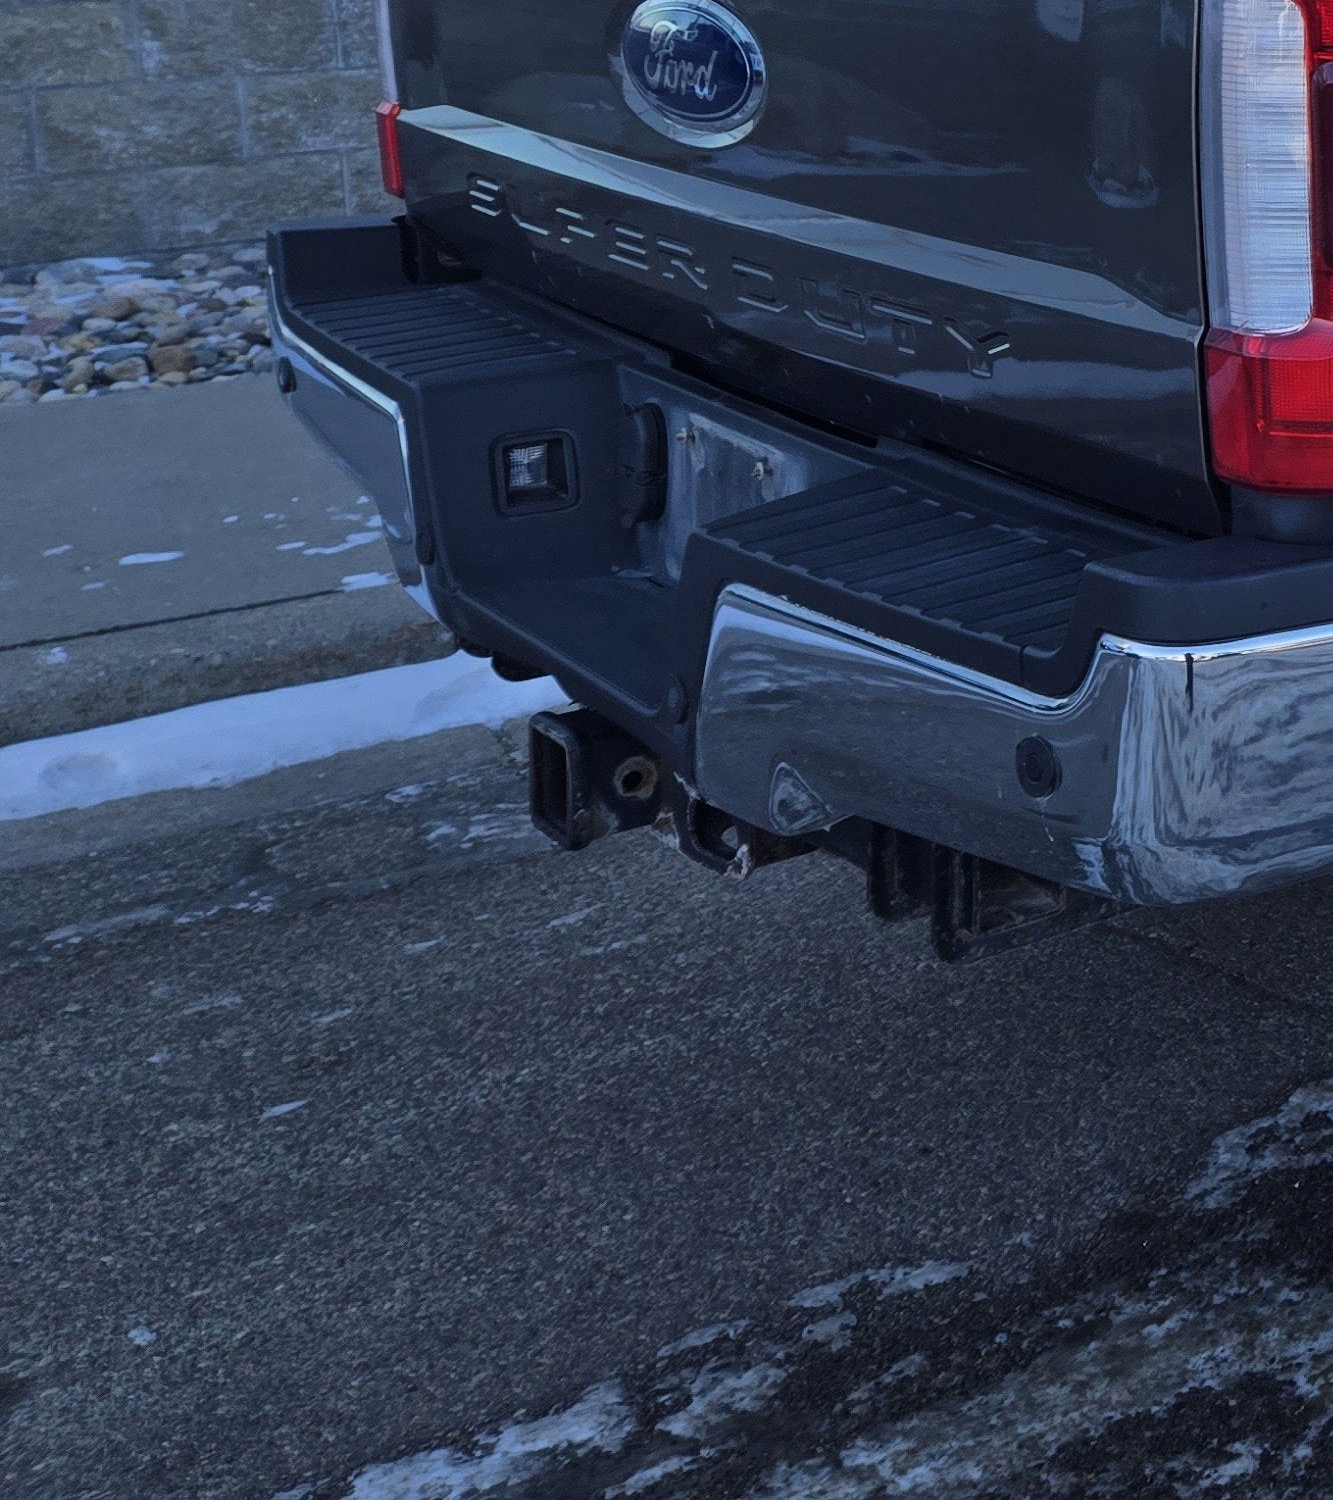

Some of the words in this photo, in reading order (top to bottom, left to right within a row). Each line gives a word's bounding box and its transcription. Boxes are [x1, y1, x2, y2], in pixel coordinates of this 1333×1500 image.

[643, 20, 719, 102] Ford
[469, 171, 708, 290] SUPER
[730, 255, 1011, 379] DUTY
